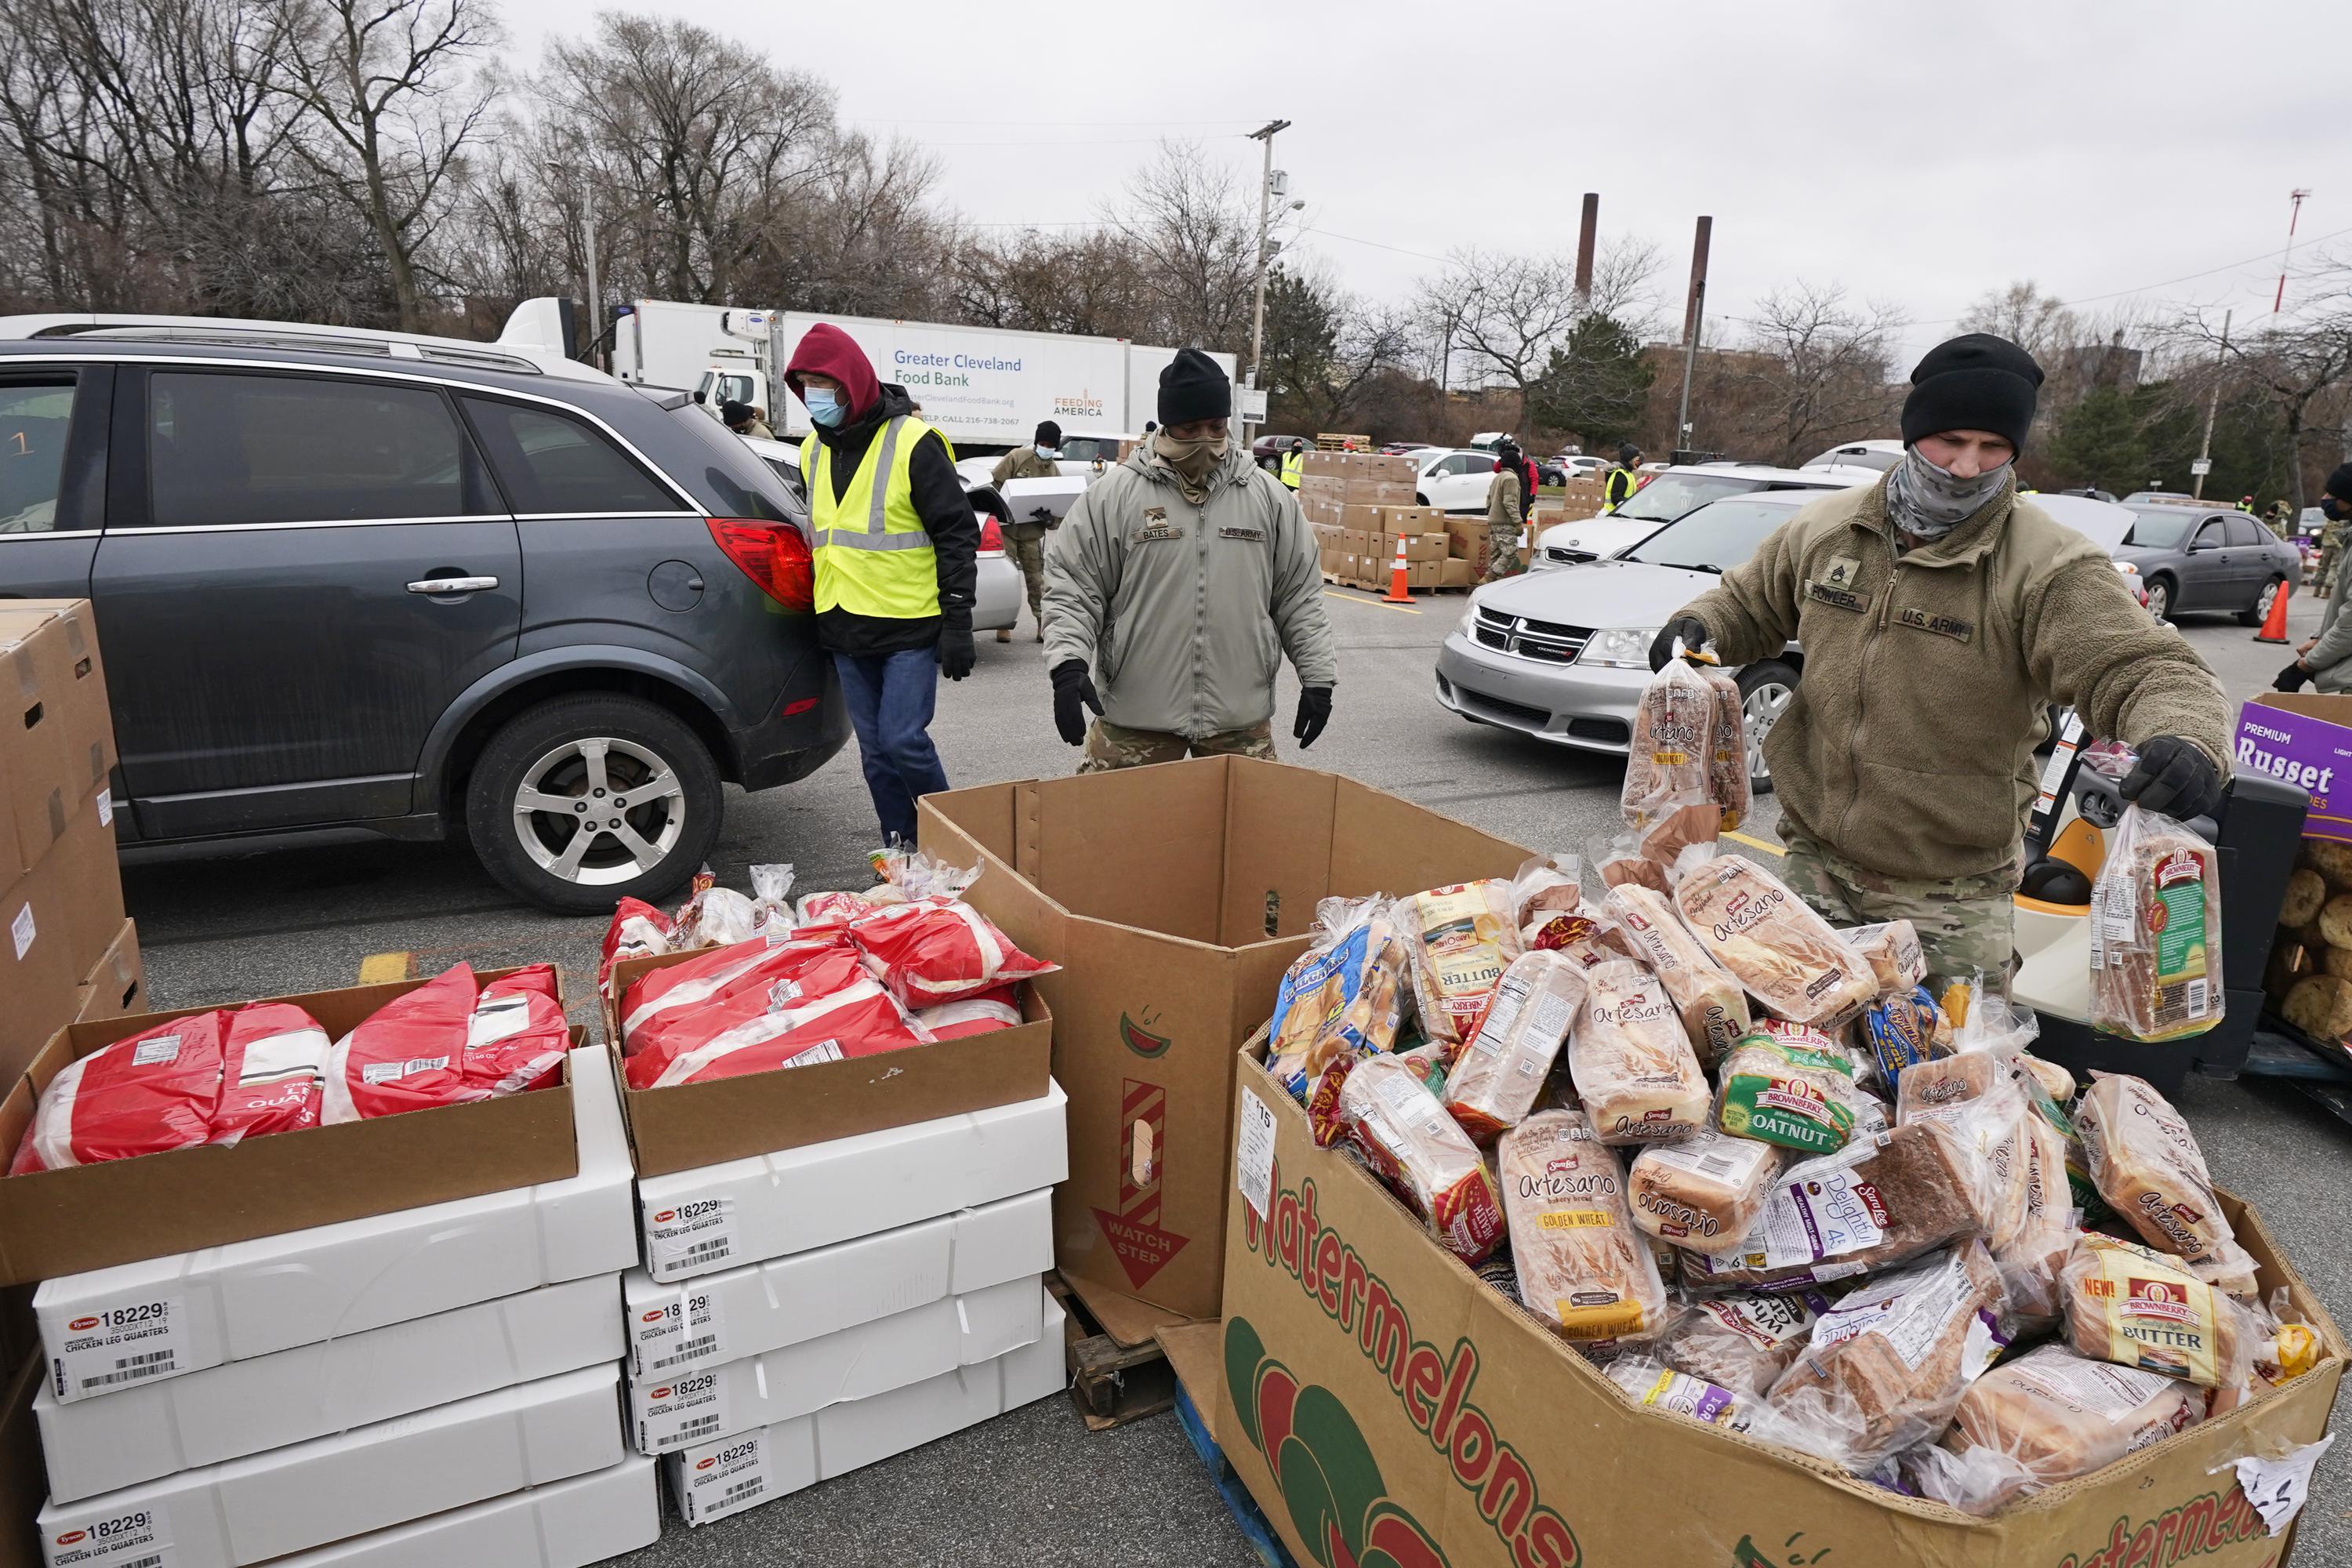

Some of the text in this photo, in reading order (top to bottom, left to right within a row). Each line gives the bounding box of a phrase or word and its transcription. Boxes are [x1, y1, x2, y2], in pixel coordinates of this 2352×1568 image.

[895, 350, 1021, 371] Greater Cleveland
[895, 370, 969, 387] Food Bank
[909, 393, 1014, 408] aterClevelandFoodBank.org
[1055, 397, 1102, 408] FEEDING
[965, 416, 1019, 425] 216-738-2067
[1054, 407, 1102, 417] AMERICA
[1143, 529, 1169, 539] BATES
[1225, 527, 1261, 539] U.S. ARMY
[1812, 586, 1857, 607] FOWLER
[1902, 610, 1967, 637] U.S. ARMY
[1537, 646, 1566, 655] DODGE
[2244, 721, 2292, 745] PREMIUM
[2237, 736, 2334, 794] Russet
[2165, 863, 2196, 877] BROWNBERRY
[1443, 967, 1501, 986] BUTTER
[1451, 1000, 1484, 1011] NBERRY
[1890, 1010, 1911, 1033] Ball
[1768, 1093, 1822, 1113] BROWNBERRY
[1645, 1111, 1658, 1120] Sara
[1752, 1114, 1828, 1146] OATNUT
[1549, 1160, 1577, 1171] Sara Lee
[1548, 1195, 1593, 1205] bakery bread
[1796, 1196, 1807, 1221] HEALTHY
[1824, 1174, 1879, 1243] Delightful
[1859, 1186, 1888, 1226] Sara Lee
[657, 1200, 717, 1222] Tyson 18229
[1474, 1203, 1494, 1240] HEALTH
[1486, 1203, 1501, 1227] NUT
[1543, 1214, 1606, 1227] GOLDEN WHEAT
[680, 1226, 691, 1235] LEG
[692, 1217, 723, 1231] QUARTERS
[1108, 1220, 1171, 1252] WATCH
[1663, 1225, 1687, 1236] Sara Lee
[1117, 1242, 1160, 1265] STEP
[2085, 1278, 2114, 1298] NEW!
[72, 1303, 162, 1330] Tyson 18229
[646, 1296, 706, 1321] Tyson 1829
[1747, 1297, 1783, 1334] Who
[2129, 1301, 2187, 1316] BROWNBERRY
[641, 1324, 679, 1341] CHICKEN LEG
[1568, 1319, 1638, 1338] GOLDEN WHEAT
[1725, 1314, 1771, 1345] PEERIDGE
[2136, 1318, 2163, 1328] Country
[65, 1326, 169, 1353] CHICKEN LEG QUARTERS
[2122, 1325, 2201, 1348] BUTTER
[1243, 1154, 1584, 1568] Watermelons
[1581, 1345, 1642, 1361] tesano
[672, 1375, 713, 1396] 18229
[648, 1405, 673, 1417] CHICKEN
[686, 1395, 717, 1407] QUARTERS
[699, 1442, 753, 1469] Tyson 18229
[694, 1458, 759, 1487] CHICKEN LEG QUARTERS
[60, 1512, 146, 1543] Tyson 18229
[55, 1534, 154, 1566] CHICKEN LEG QUARTERS
